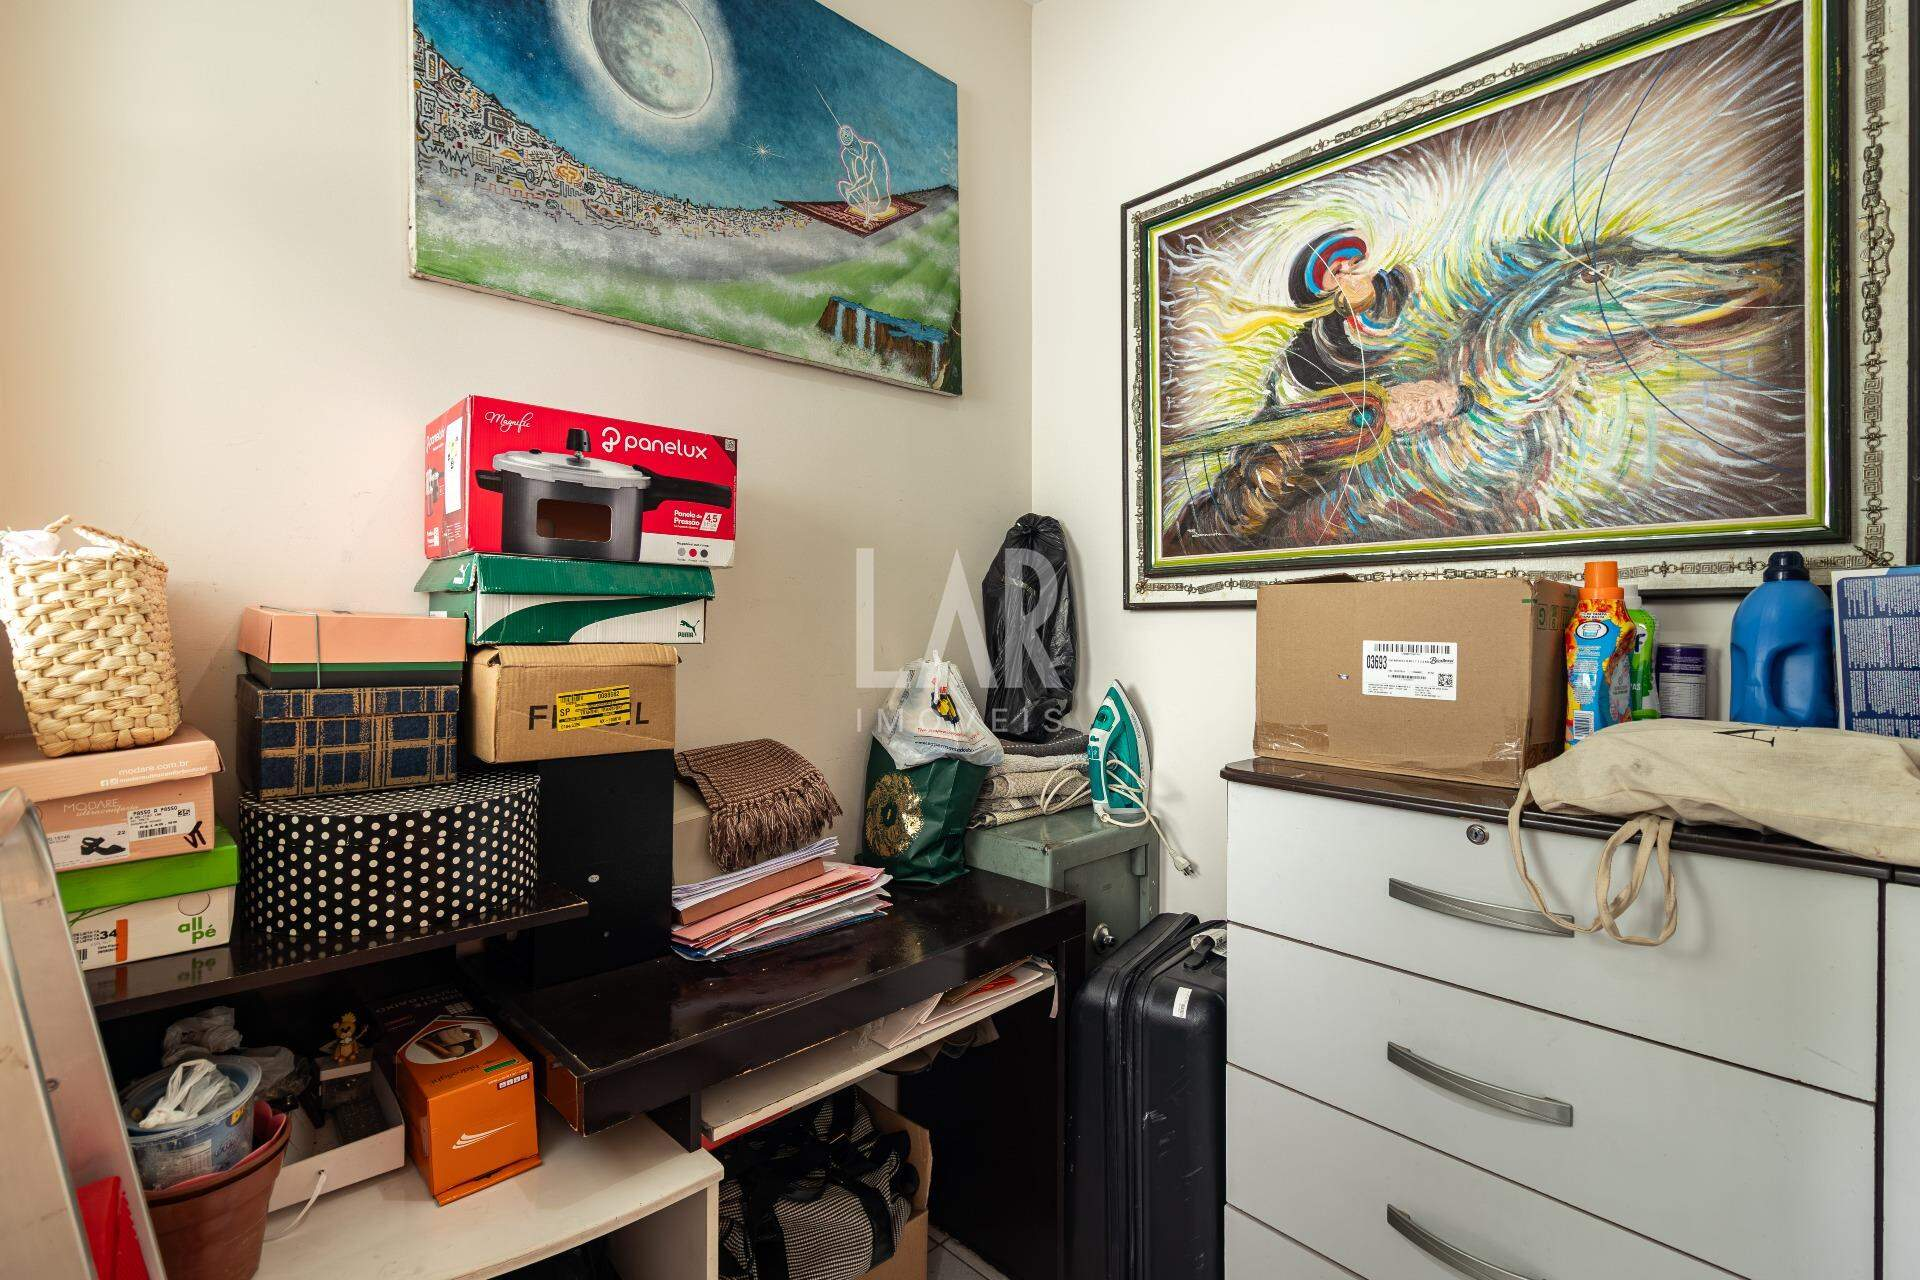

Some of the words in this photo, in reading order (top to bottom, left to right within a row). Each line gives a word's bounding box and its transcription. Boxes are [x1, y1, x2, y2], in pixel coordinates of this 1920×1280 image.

[485, 411, 534, 433] Magnific
[624, 435, 708, 460] panelux
[1366, 655, 1388, 669] 03693
[559, 707, 571, 717] SP
[63, 799, 119, 813] MODARE
[178, 916, 202, 933] all
[99, 929, 117, 940] 34
[192, 924, 217, 945] pé
